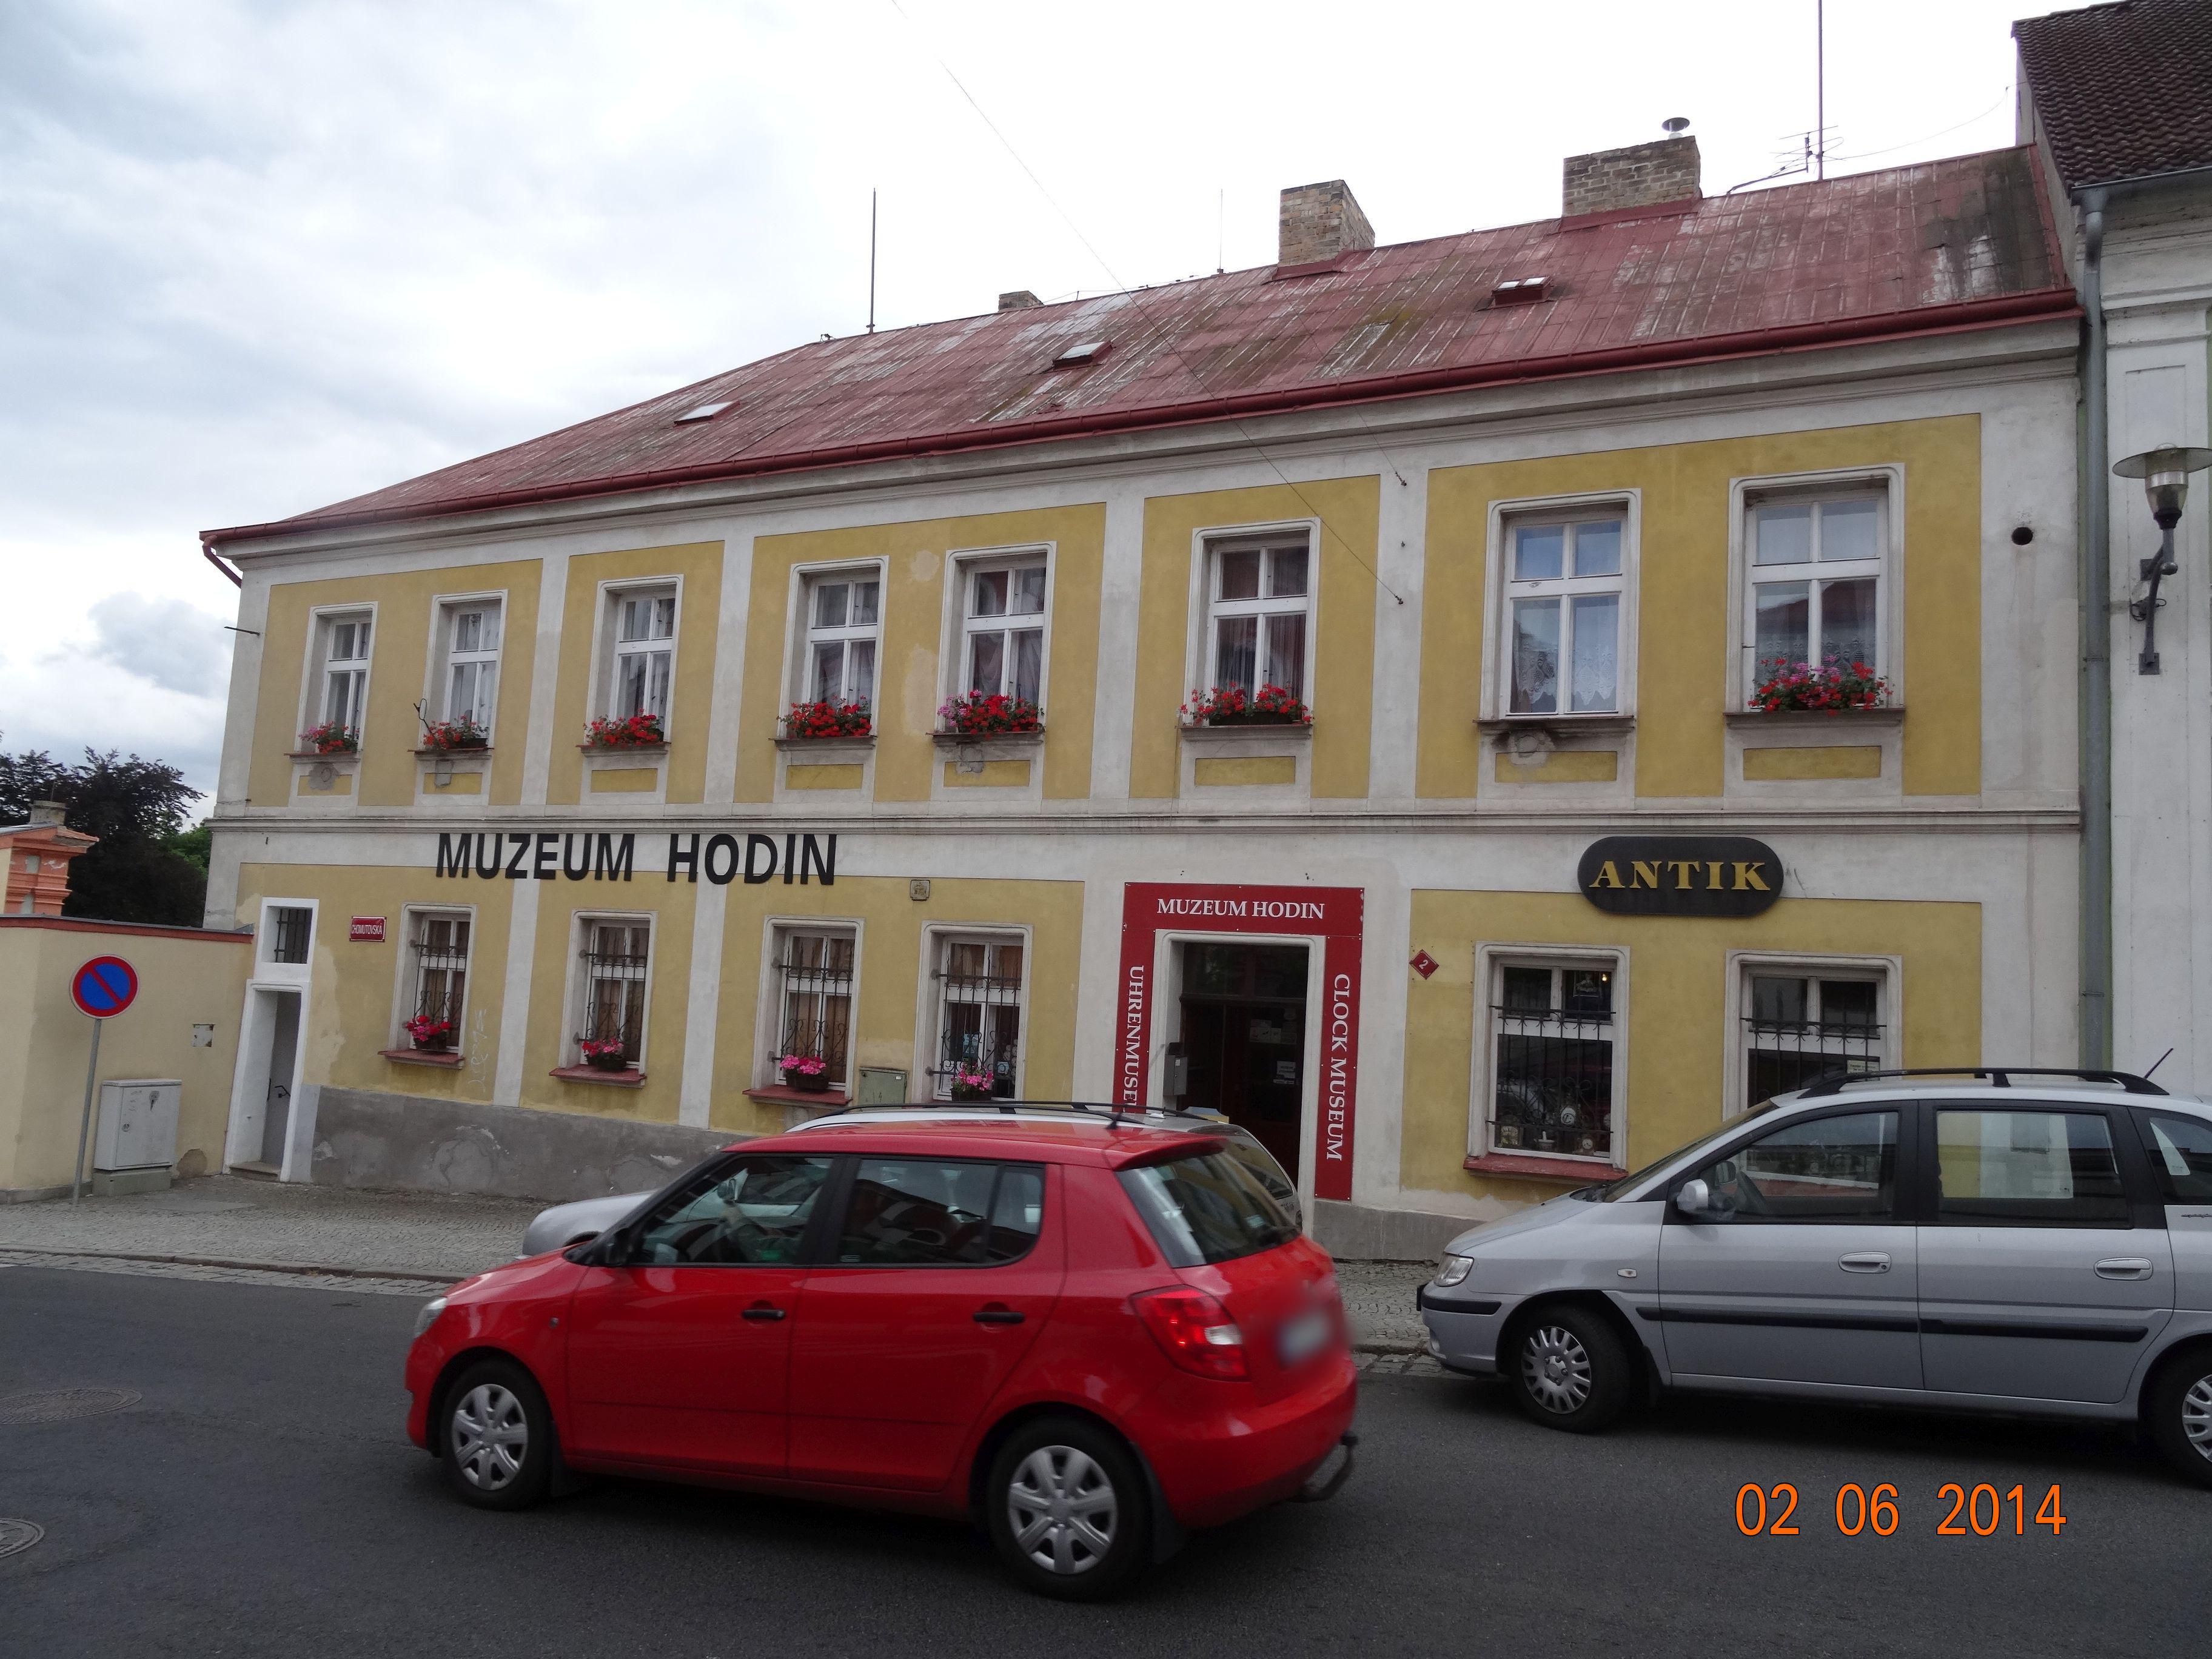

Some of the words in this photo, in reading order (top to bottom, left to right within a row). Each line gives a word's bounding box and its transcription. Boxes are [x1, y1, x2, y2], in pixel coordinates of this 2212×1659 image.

[436, 833, 634, 881] MUZEUM
[668, 833, 837, 885] HODIN
[1589, 860, 1771, 891] ANTIK
[1157, 898, 1247, 916] MUZEUM
[1252, 901, 1324, 919] HODIN
[1419, 959, 1429, 970] 2
[1332, 974, 1350, 1051] CLOCK
[1327, 1057, 1346, 1160] MUSEUM
